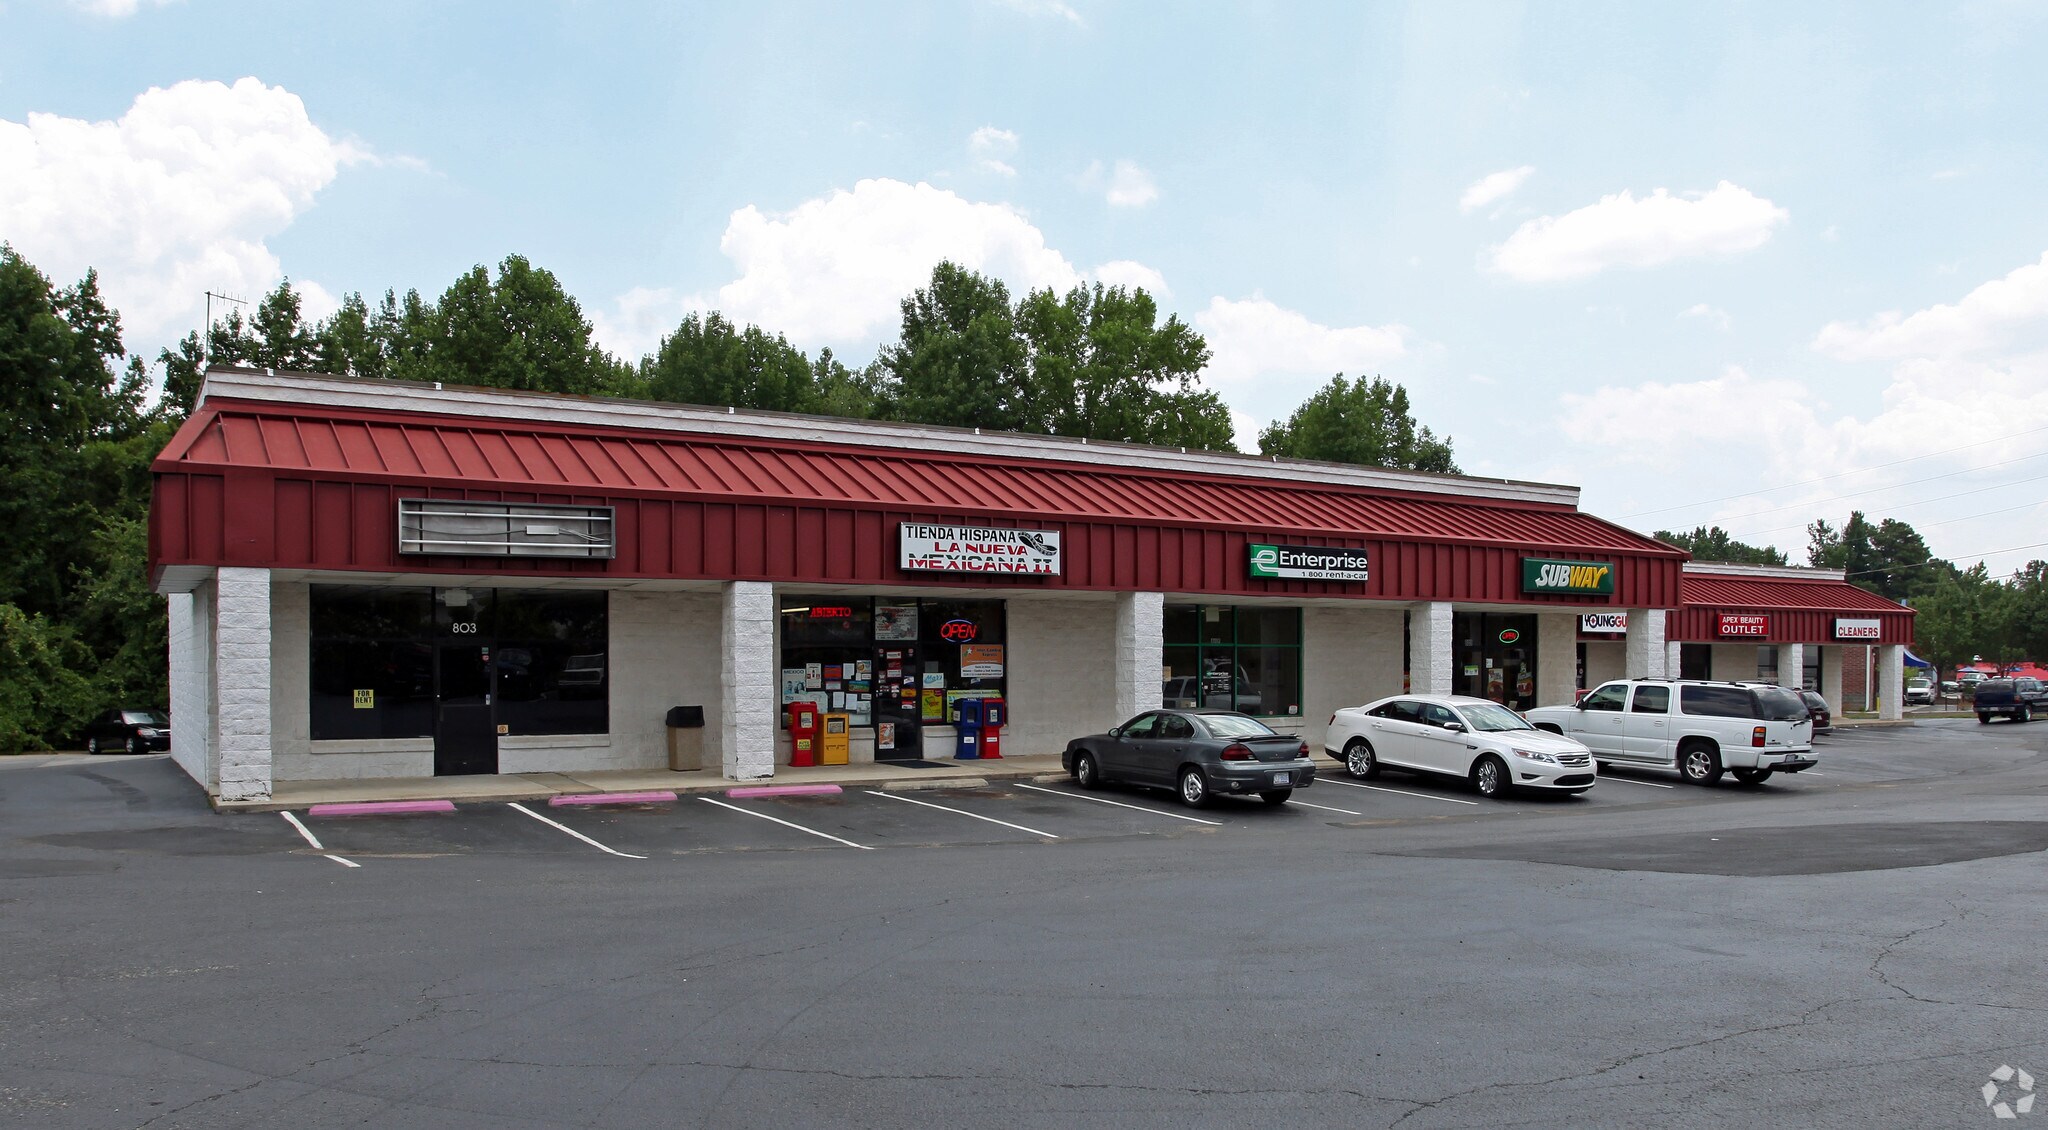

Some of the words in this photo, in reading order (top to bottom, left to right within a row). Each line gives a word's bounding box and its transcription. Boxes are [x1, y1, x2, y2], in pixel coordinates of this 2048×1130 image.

[905, 526, 955, 540] TIENDA
[960, 528, 1016, 543] HISPANA
[934, 542, 961, 553] LA
[965, 543, 1028, 556] NUEVA
[908, 553, 1028, 572] MEXICANA
[1032, 558, 1052, 573] II
[1280, 551, 1368, 571] Enterprise
[1535, 564, 1608, 589] SUBWAY
[810, 607, 851, 618] ABIERTO
[1722, 616, 1738, 624] APEX
[1740, 616, 1764, 624] BEAUTY
[452, 622, 477, 634] 803
[941, 623, 977, 639] OPEN
[1722, 625, 1764, 634] OUTLET
[1838, 626, 1879, 637] CLEANERS
